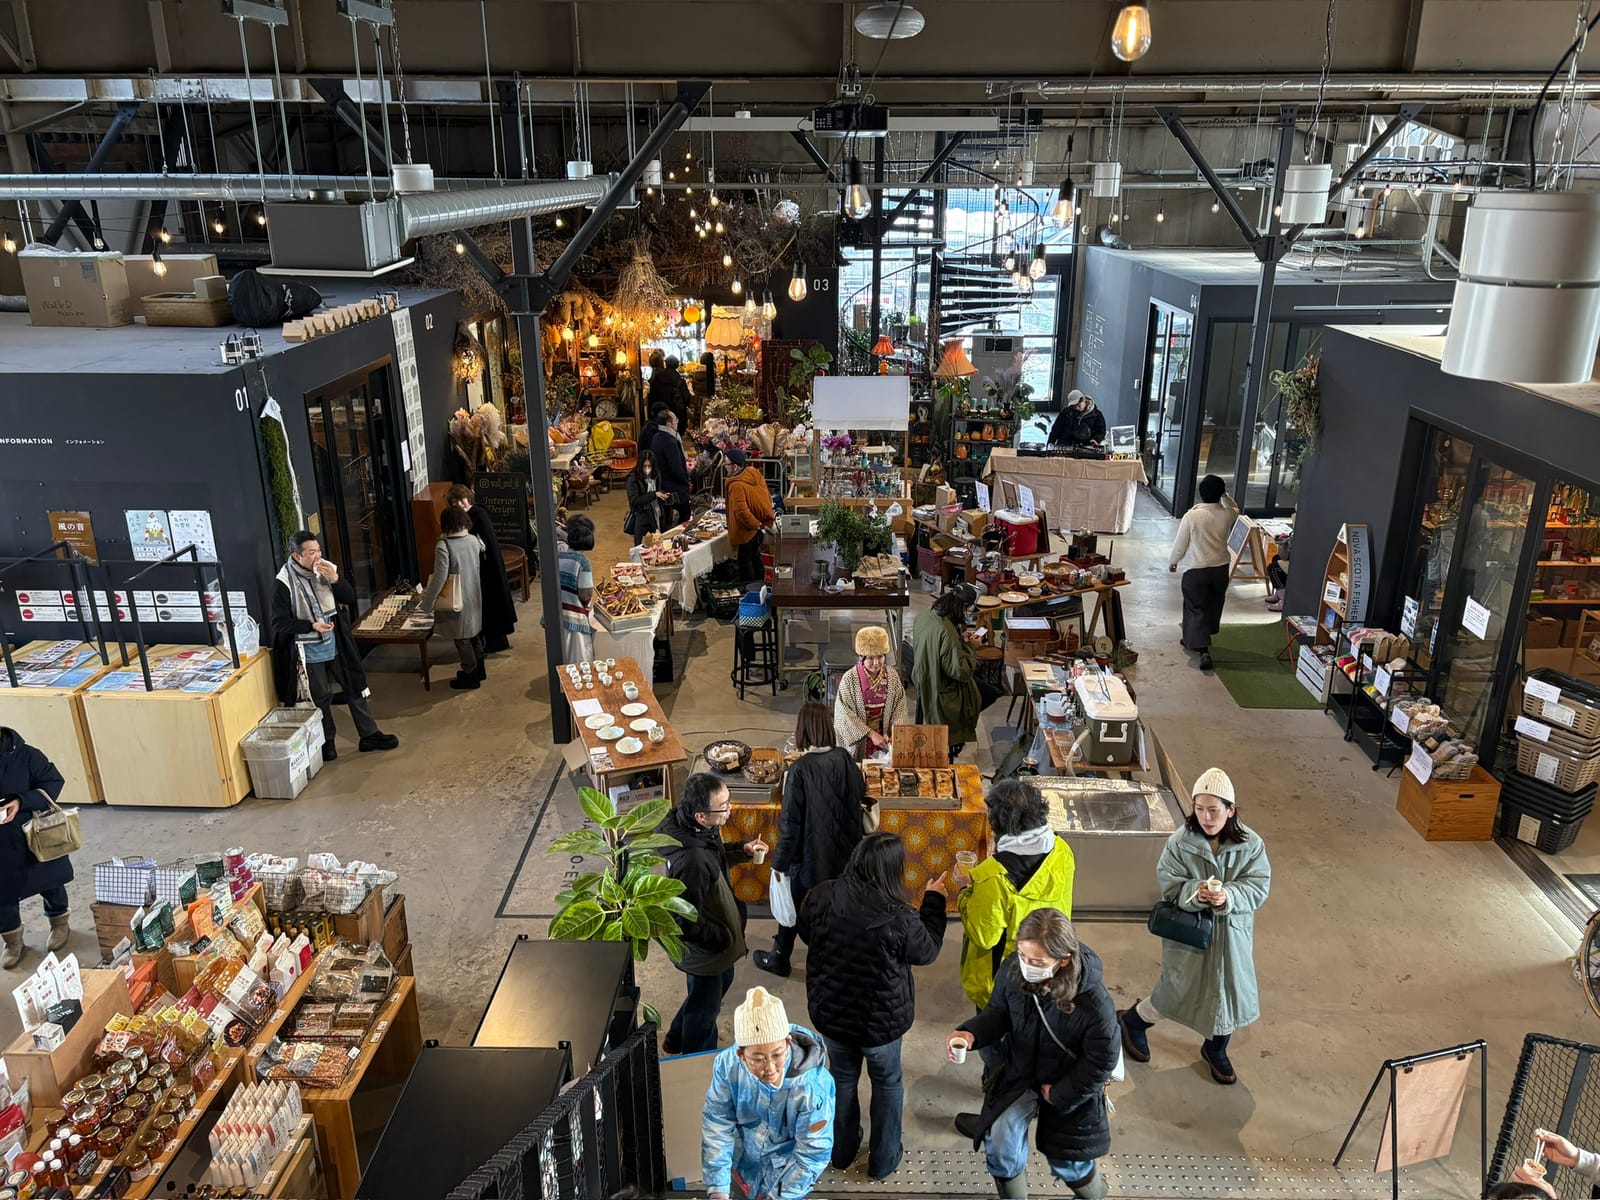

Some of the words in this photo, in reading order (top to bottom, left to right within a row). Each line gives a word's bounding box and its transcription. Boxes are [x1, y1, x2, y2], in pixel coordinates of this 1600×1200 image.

[813, 278, 830, 292] 03
[425, 313, 434, 331] 02
[235, 386, 250, 412] 01
[1351, 530, 1361, 555] NOVA
[1353, 557, 1362, 589] SCOTIA
